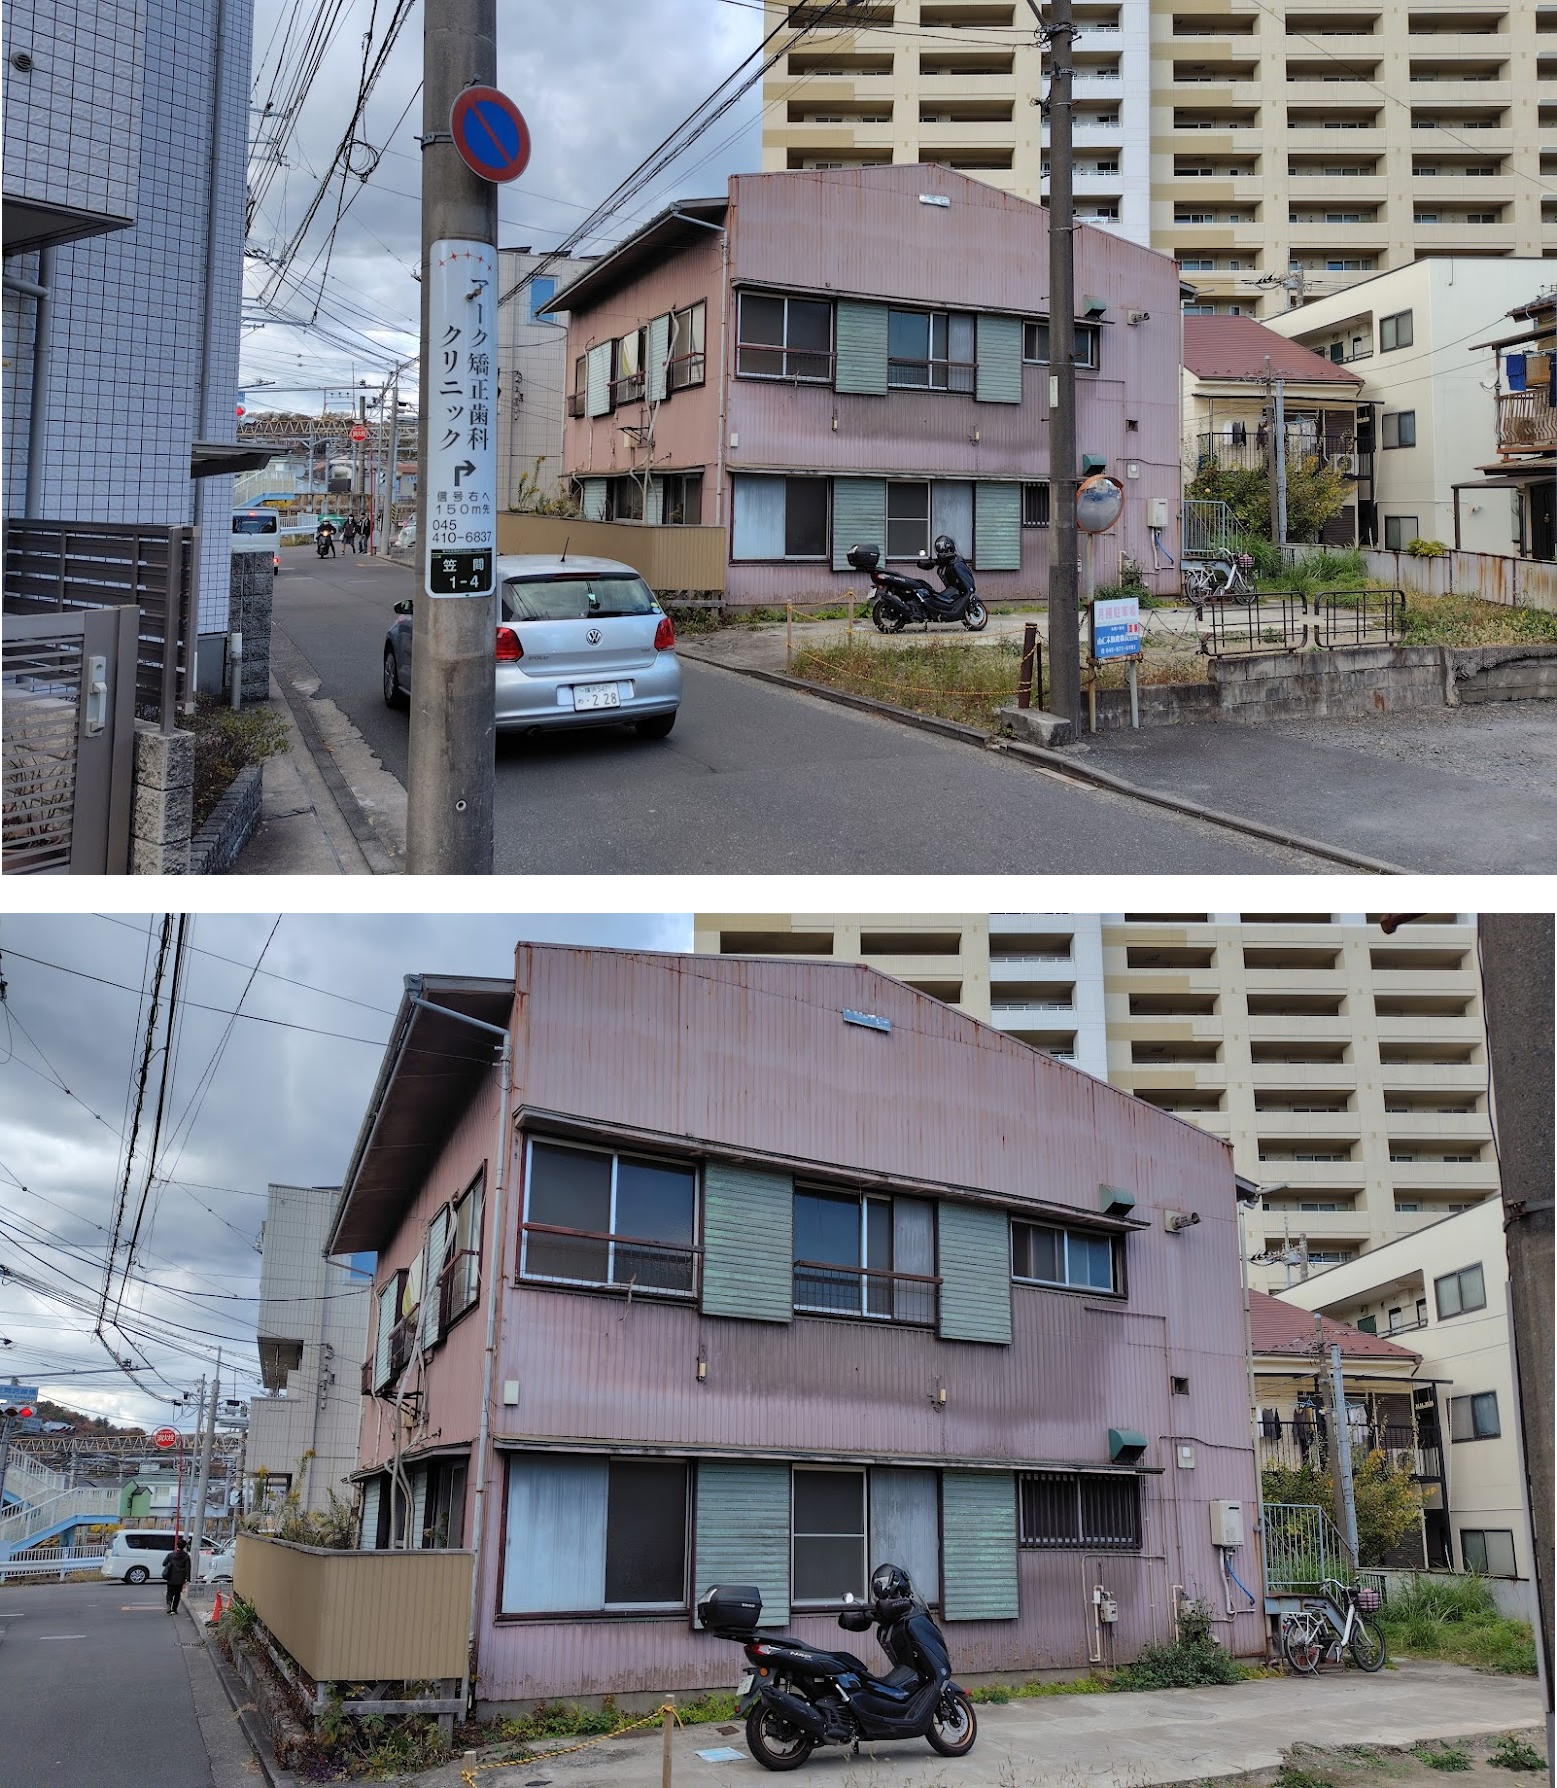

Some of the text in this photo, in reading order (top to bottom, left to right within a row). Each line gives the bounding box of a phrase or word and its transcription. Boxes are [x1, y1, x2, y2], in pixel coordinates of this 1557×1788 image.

[467, 279, 490, 451] アーク矯正歯科
[438, 325, 463, 451] クリニック
[437, 491, 490, 503] 信号右へ
[436, 503, 490, 515] 150m先
[432, 519, 457, 531] 045
[432, 531, 492, 544] 410-6837
[442, 557, 485, 573] 笠間
[449, 575, 479, 589] 1-4
[156, 1433, 175, 1442] 消火栓
